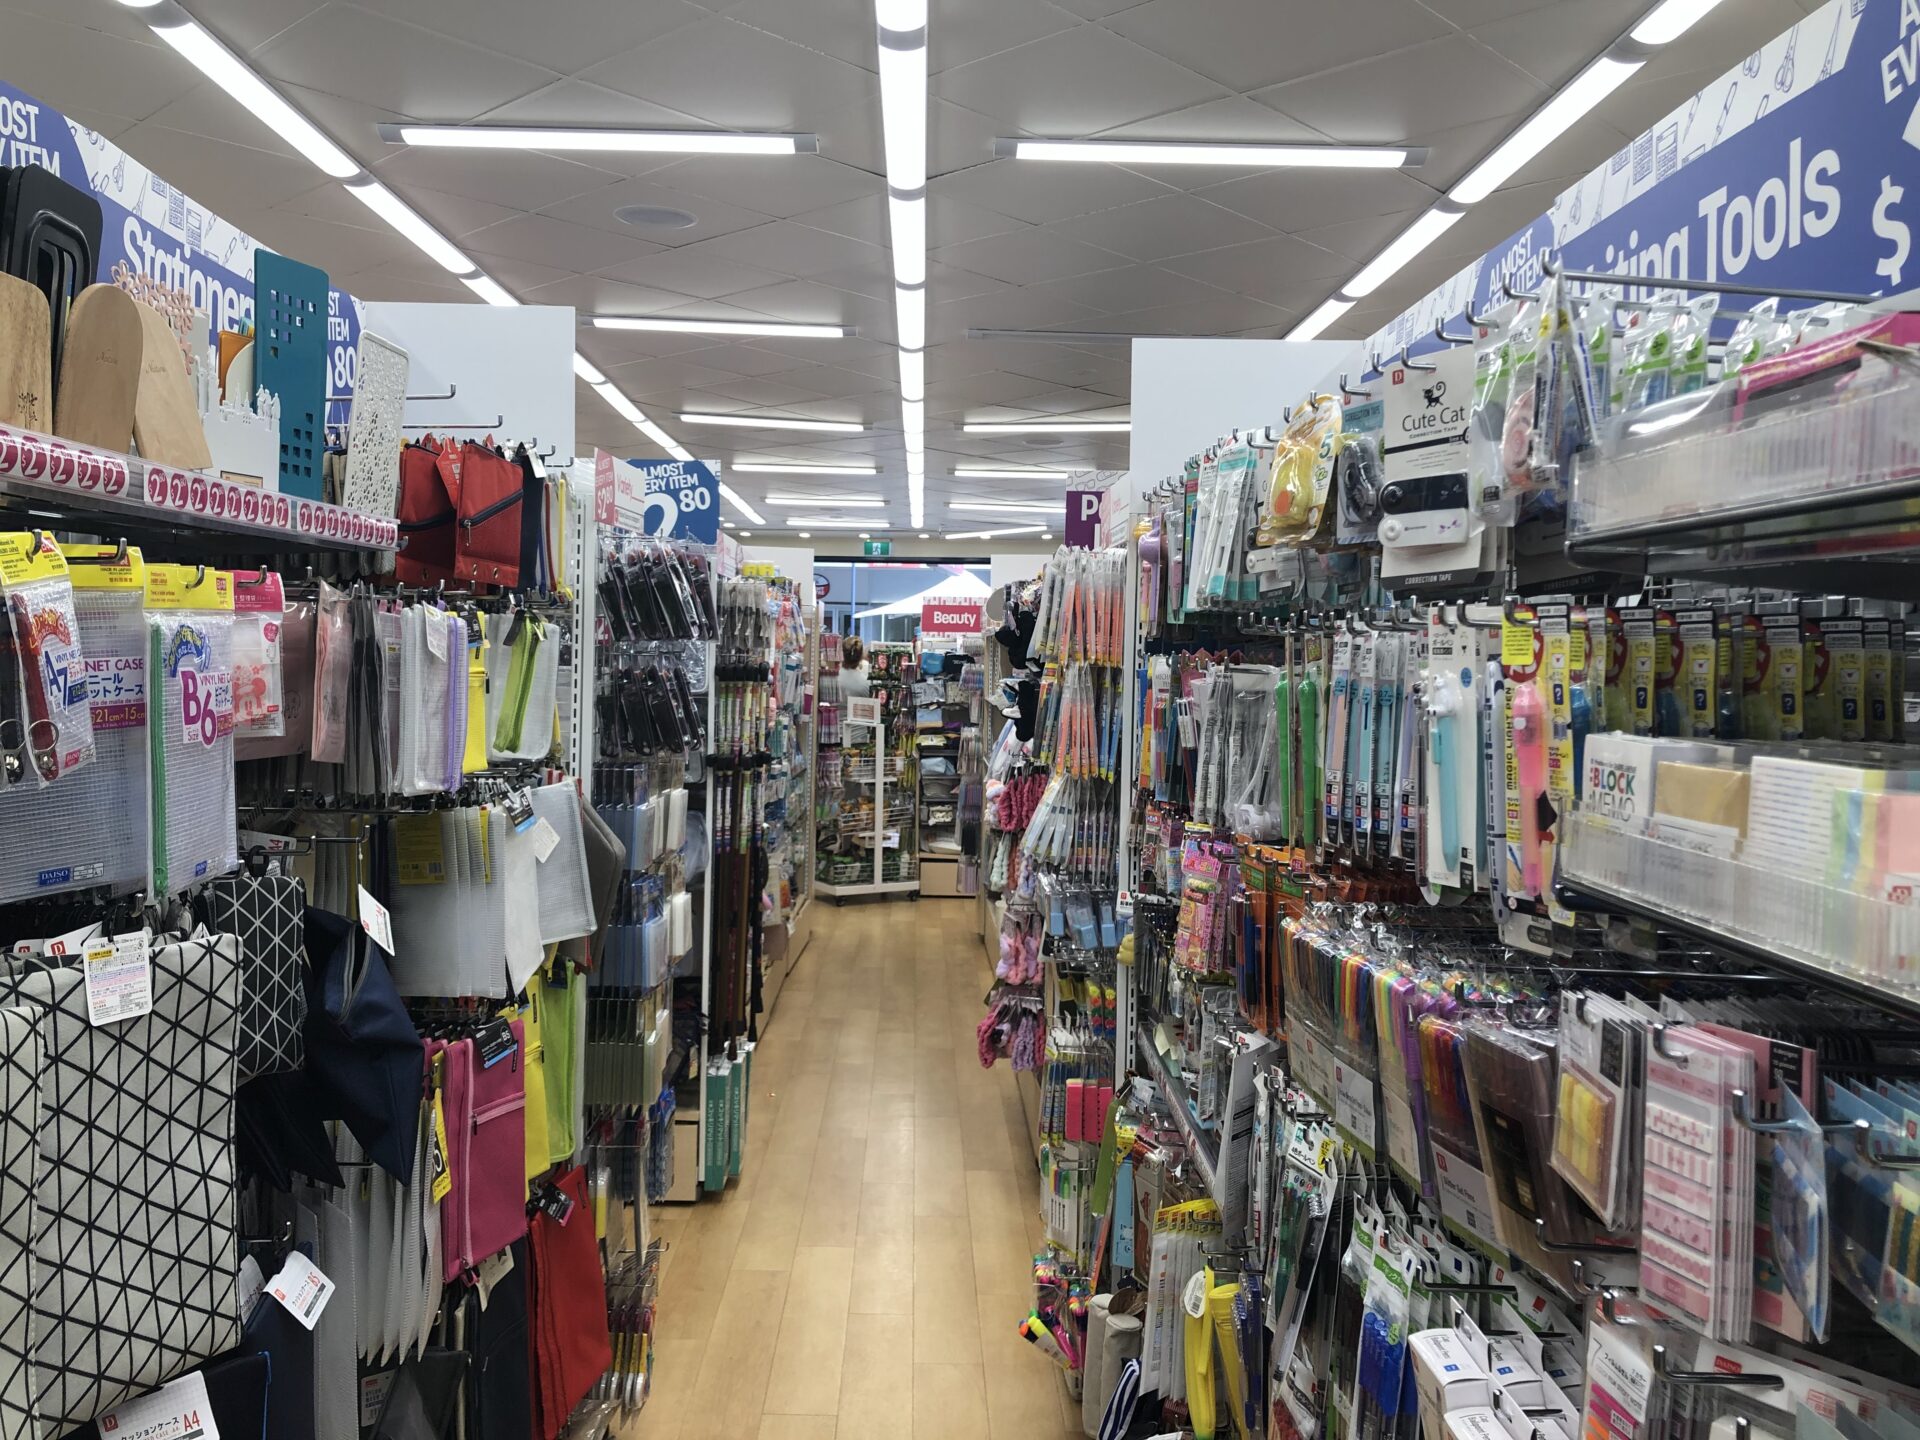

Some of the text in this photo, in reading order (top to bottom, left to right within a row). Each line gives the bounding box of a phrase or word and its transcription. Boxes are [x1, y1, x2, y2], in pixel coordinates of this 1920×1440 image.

[1699, 137, 1841, 283] Tools
[1402, 406, 1465, 432] Cute Cat
[669, 473, 699, 490] ITEM
[933, 611, 977, 627] Beauty
[85, 658, 144, 673] NET CASE
[1593, 767, 1635, 796] BLOCK
[41, 869, 68, 881] DAISO
[183, 1410, 201, 1432] A4
